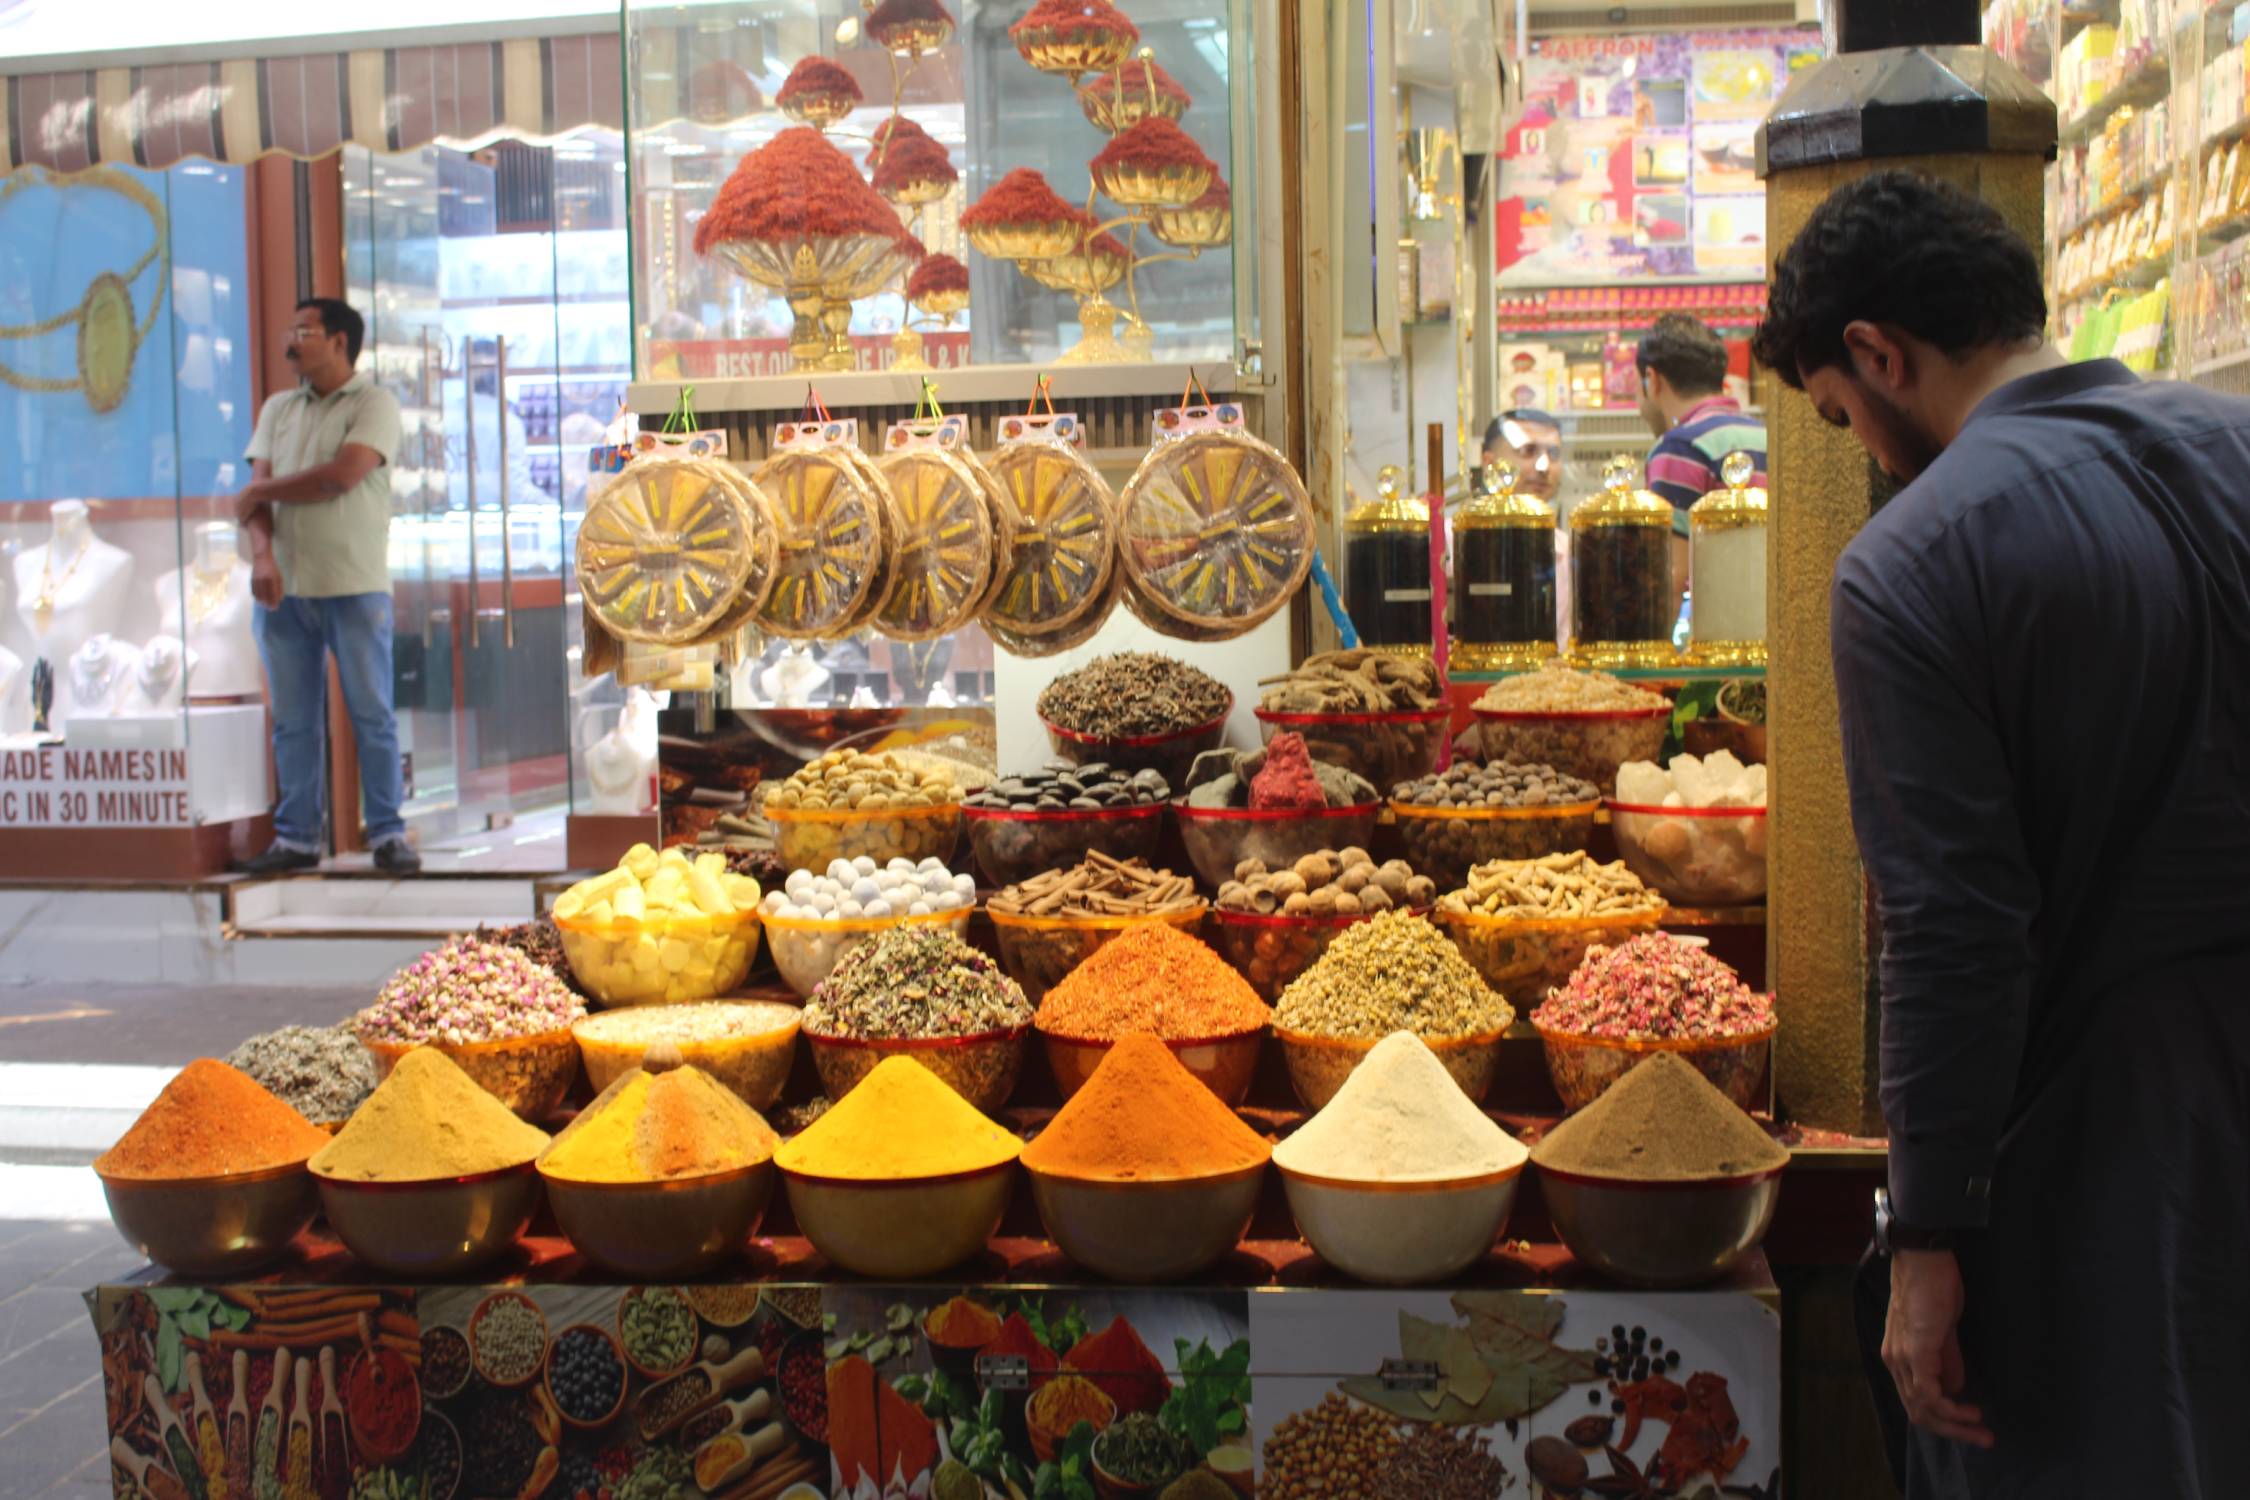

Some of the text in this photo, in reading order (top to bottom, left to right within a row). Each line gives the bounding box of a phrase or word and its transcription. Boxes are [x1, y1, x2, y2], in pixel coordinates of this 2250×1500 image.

[1540, 37, 1653, 60] SAFFRON
[716, 351, 763, 377] BEST
[0, 750, 53, 781] ADE
[27, 791, 50, 823] IN
[60, 791, 88, 823] 30
[97, 791, 189, 823] MINUTE
